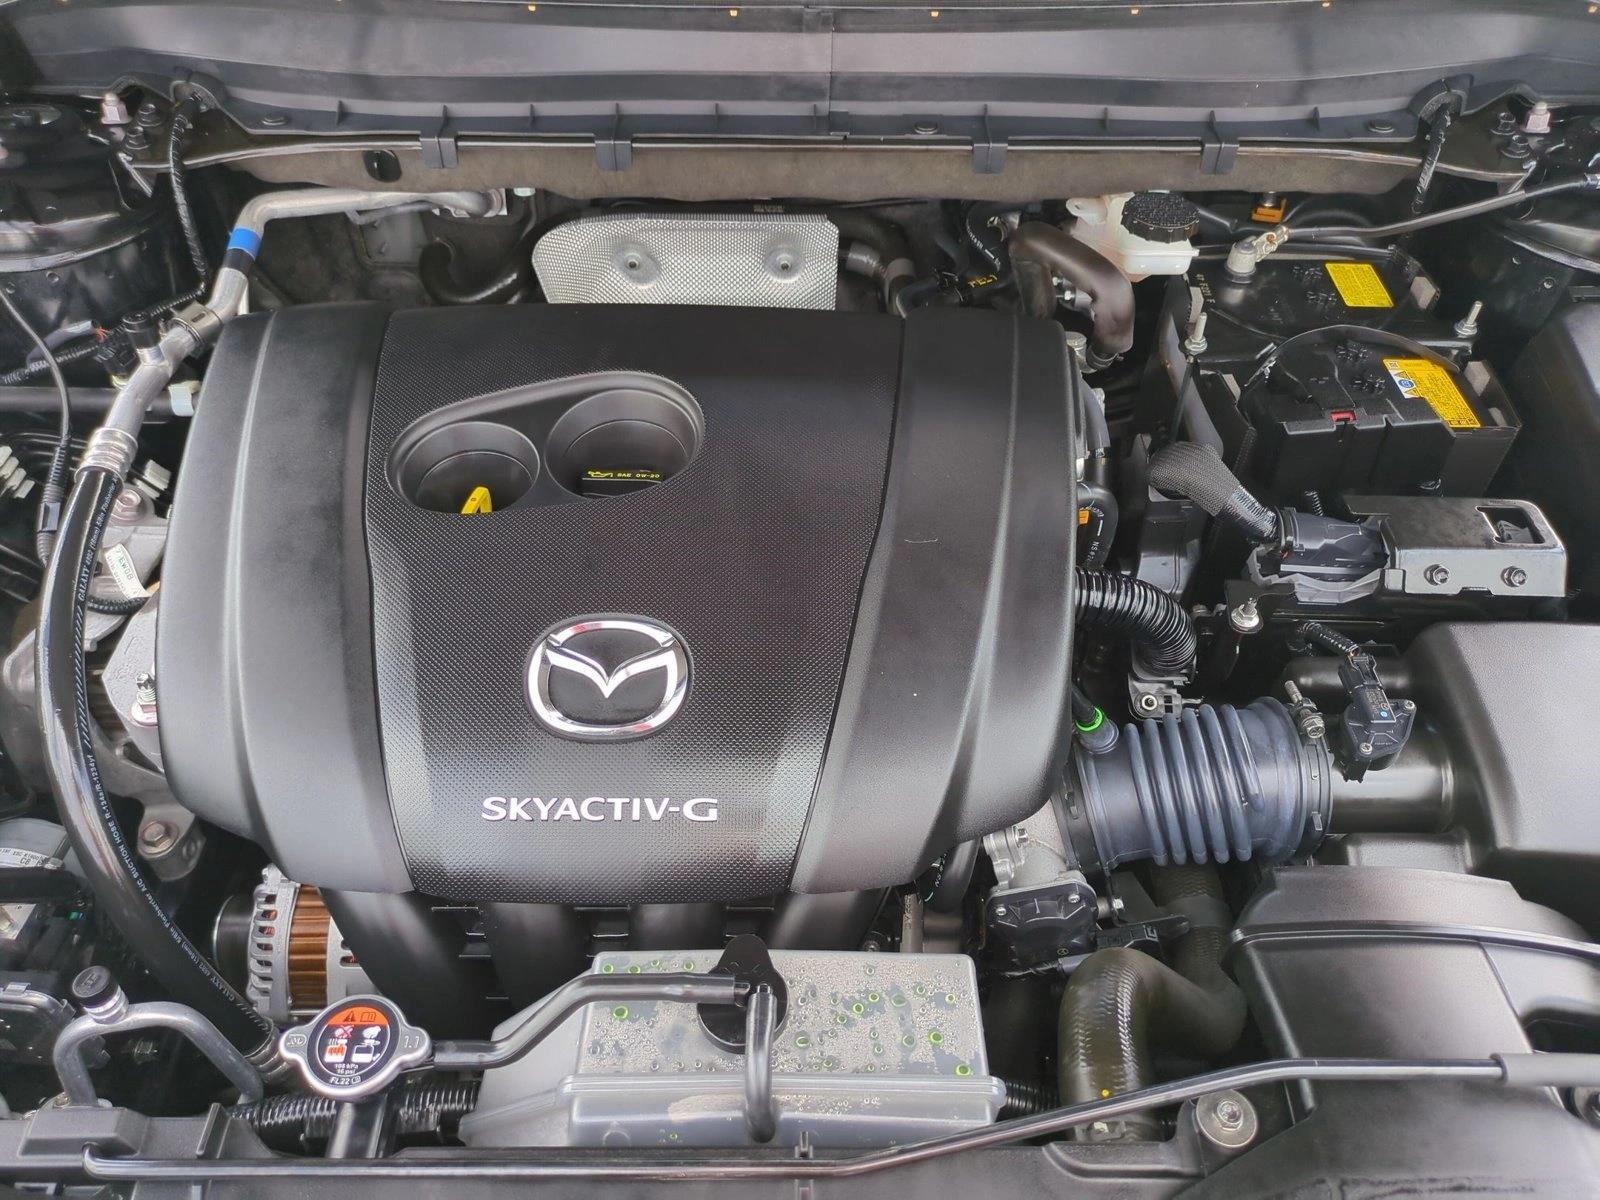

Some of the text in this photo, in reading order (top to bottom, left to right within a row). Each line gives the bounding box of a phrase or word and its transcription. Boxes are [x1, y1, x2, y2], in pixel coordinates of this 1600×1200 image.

[78, 564, 91, 602] GALAXY
[481, 796, 718, 822] SKYACTIV-G
[108, 821, 126, 848] HOSE
[118, 845, 142, 880] SUCTION
[136, 879, 147, 893] A/C
[210, 976, 235, 1001] GALAXY
[329, 1076, 350, 1085] FL22
